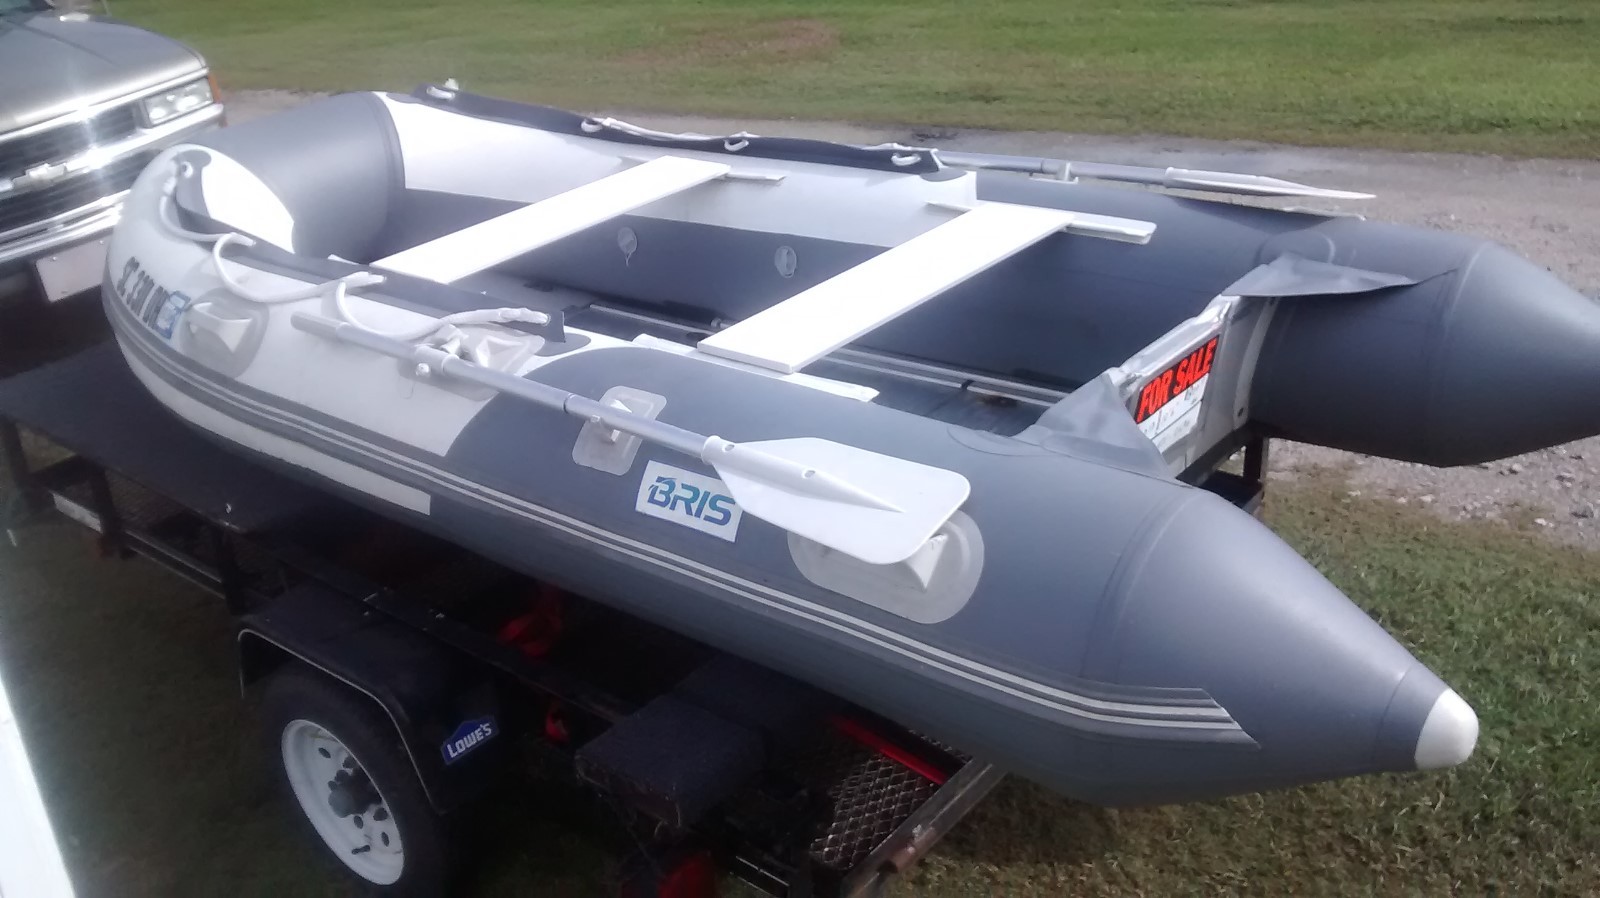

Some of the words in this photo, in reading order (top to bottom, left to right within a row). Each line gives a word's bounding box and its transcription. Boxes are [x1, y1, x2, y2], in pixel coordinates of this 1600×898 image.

[1136, 369, 1174, 423] FOR
[1172, 337, 1218, 395] SALE
[647, 476, 736, 526] BRIS
[446, 722, 492, 758] LOWE'S
